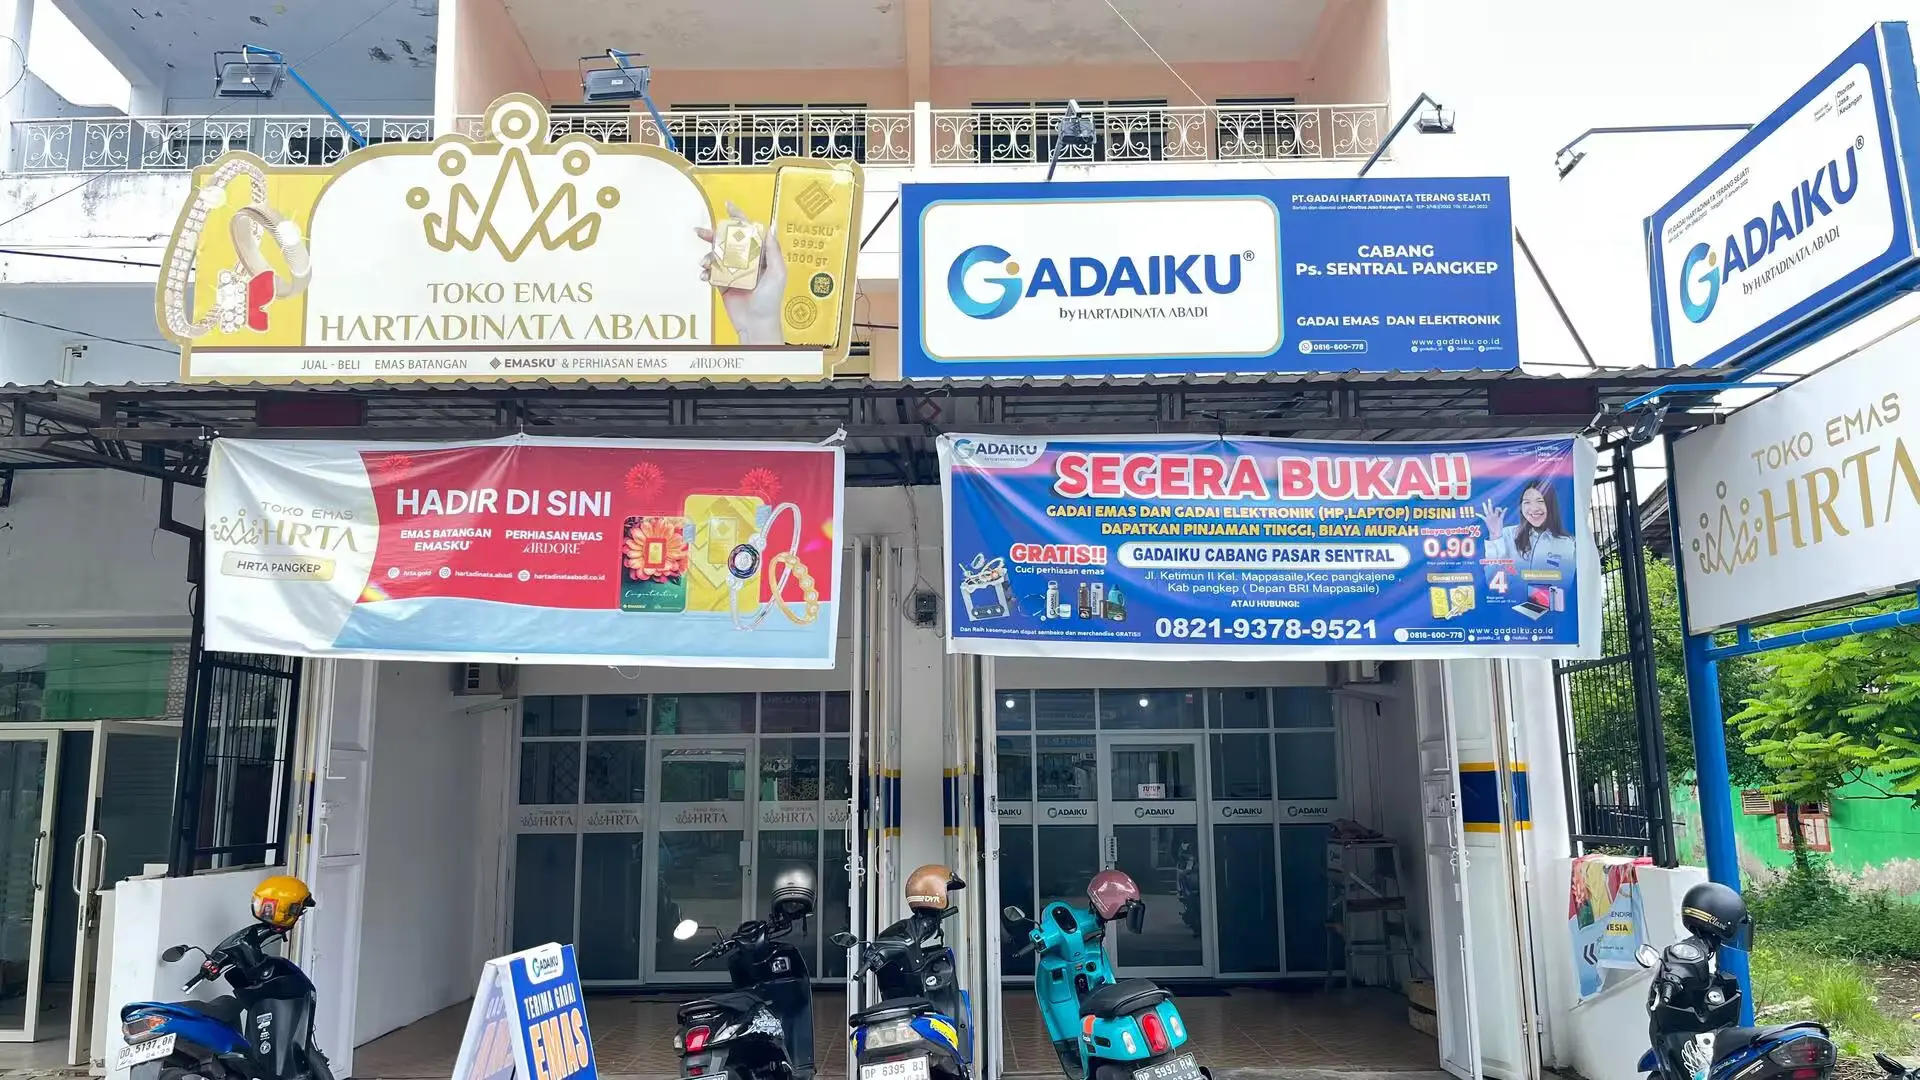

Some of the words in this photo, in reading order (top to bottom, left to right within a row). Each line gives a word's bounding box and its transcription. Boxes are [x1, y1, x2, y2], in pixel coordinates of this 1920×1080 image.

[1291, 194, 1339, 204] PT.GADAI
[1340, 194, 1413, 203] HARTADINATA
[1414, 193, 1456, 203] TERANG
[1456, 193, 1491, 202] SEJATI
[786, 252, 813, 264] 1000
[1357, 244, 1434, 258] CABANG
[1742, 282, 1754, 295] by
[1754, 246, 1811, 290] HARTADINATA
[1811, 225, 1840, 254] ABADI
[1296, 263, 1322, 276] Ps.
[1326, 262, 1408, 276] SENTRAL
[1412, 261, 1499, 275] PANGKEP
[426, 282, 505, 305] TOKO
[513, 281, 593, 304] EMAS
[1059, 307, 1077, 322] by
[1078, 307, 1166, 320] HARTADINATA
[1168, 306, 1208, 319] ABADI
[1296, 316, 1339, 326] GADAI
[1342, 316, 1379, 326] EMAS
[1386, 315, 1415, 326] DAN
[1419, 315, 1501, 325] ELEKTRONIK
[319, 313, 576, 341] HARTADINATA
[584, 312, 699, 340] ABADI
[1313, 343, 1364, 351] 0816-600-778
[1411, 337, 1500, 346] www.gadaiku.co.id
[301, 360, 328, 370] JUAL
[338, 360, 360, 370] BELI
[375, 359, 405, 370] EMAS
[408, 359, 468, 369] BATANGAN
[504, 358, 556, 368] EMASKU
[561, 358, 569, 369] &
[572, 358, 634, 369] PERHIASAN
[637, 358, 668, 368] EMAS
[1751, 431, 1814, 476] TOKO
[1826, 392, 1901, 447] EMAS
[1056, 454, 1268, 499] SEGERA
[1278, 454, 1472, 500] BUKA!!
[396, 488, 498, 516] HADIR
[506, 489, 540, 516] DI
[546, 490, 611, 517] SINI
[1758, 436, 1920, 557] HRTA
[261, 501, 304, 518] TOKO
[311, 508, 354, 520] EMAS
[1046, 505, 1091, 517] GADAI
[1095, 506, 1136, 518] EMAS
[1140, 506, 1173, 518] DAN
[1175, 507, 1220, 518] GADAI
[1223, 507, 1315, 519] ELEKTRONIK
[1319, 506, 1411, 521] (HP,LAPTOP)
[1413, 507, 1456, 519] DISINI
[261, 518, 359, 554] HRTA
[400, 529, 431, 539] EMAS
[433, 527, 492, 538] BATANGAN
[505, 530, 570, 541] PERHIASAN
[571, 532, 603, 541] EMAS
[1101, 523, 1181, 536] DAPATKAN
[1183, 524, 1260, 536] PINJAMAN
[1263, 524, 1316, 538] TINGGI,
[1319, 524, 1361, 537] BIAYA
[1364, 524, 1419, 537] MURAH
[413, 541, 470, 552] EMASKU
[1423, 537, 1476, 558] 0.90
[1010, 544, 1107, 565] GRATIS!!
[1133, 547, 1200, 562] GADAIKU
[1205, 548, 1267, 562] CABANG
[1272, 548, 1320, 563] PASAR
[1325, 548, 1395, 562] SENTRAL
[236, 560, 269, 573] HRTA
[270, 562, 322, 574] PANGKEP
[1015, 565, 1035, 574] Cuci
[1036, 566, 1079, 576] perhiasan
[1081, 568, 1105, 576] emas
[1144, 571, 1157, 581] Jl.
[1160, 571, 1205, 581] Ketimun
[1220, 572, 1239, 582] Kel.
[1331, 573, 1395, 585] pangkajene
[1489, 571, 1508, 594] 4
[1168, 583, 1191, 592] Kab
[1193, 583, 1239, 595] pangkep
[1249, 584, 1286, 595] Depan
[1289, 584, 1309, 593] BRI
[1312, 584, 1380, 595] Mappasaile)
[1256, 600, 1300, 608] HUBUNGI:
[1155, 617, 1377, 639] 0821-9378-9521
[1409, 631, 1463, 639] 0816-600-778
[1468, 627, 1554, 635] www.gadaiku.co.id
[694, 812, 728, 824] HRTA
[781, 812, 815, 823] HRTA
[1047, 808, 1088, 818] GADAIKU
[1134, 807, 1175, 818] GADAIKU
[1222, 806, 1262, 817] GADAIKU
[1287, 806, 1328, 817] GADAIKU
[539, 814, 574, 827] HRTA
[605, 814, 640, 826] HRTA
[524, 992, 554, 1020] TERIMA
[554, 983, 577, 1009] GADAI
[135, 1040, 158, 1054] 5137
[529, 1008, 589, 1080] EMAS
[865, 1069, 876, 1080] DP
[882, 1064, 905, 1077] 6395
[1138, 1072, 1150, 1080] DP
[1154, 1063, 1178, 1078] 5992
[1179, 1057, 1194, 1071] RM
